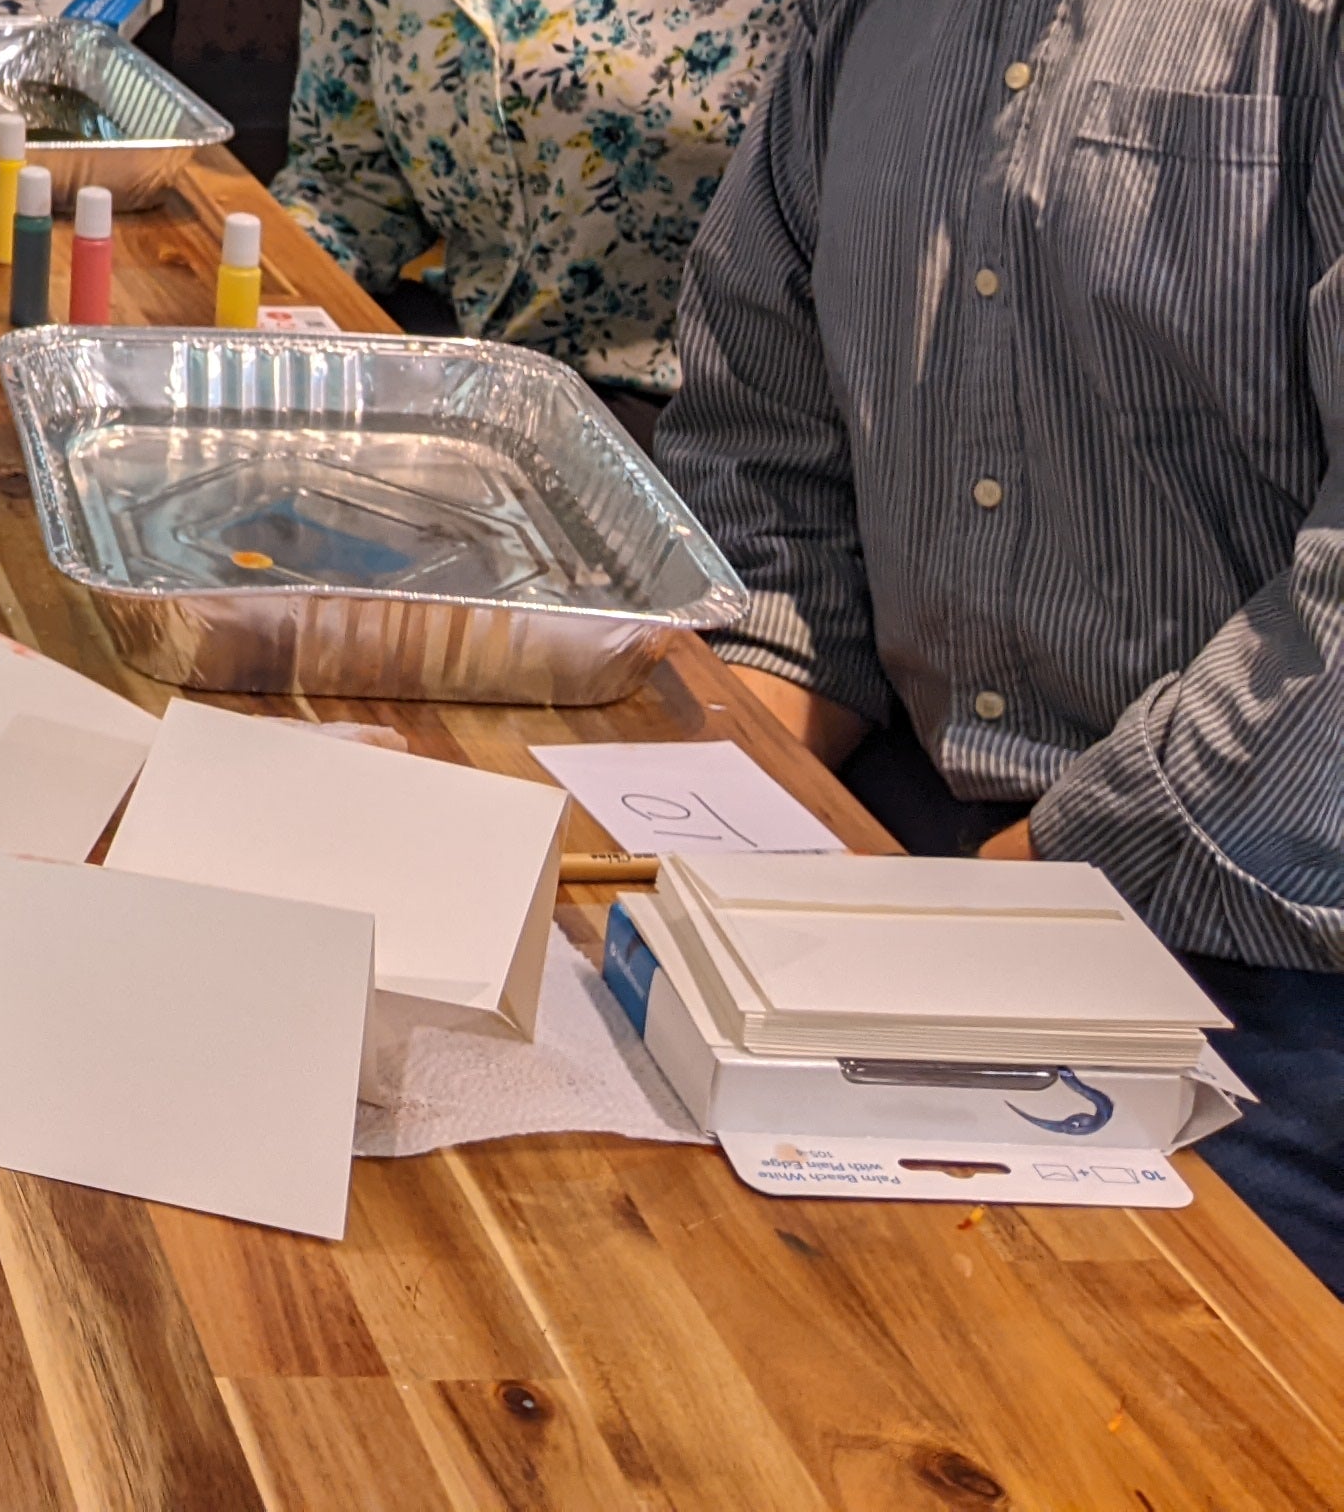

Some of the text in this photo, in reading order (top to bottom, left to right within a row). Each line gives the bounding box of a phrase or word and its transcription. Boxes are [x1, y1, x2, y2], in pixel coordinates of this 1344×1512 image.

[761, 1158, 883, 1172] with Plain Edge
[758, 1171, 902, 1185] Palm Beach White
[1141, 1169, 1166, 1182] 10
